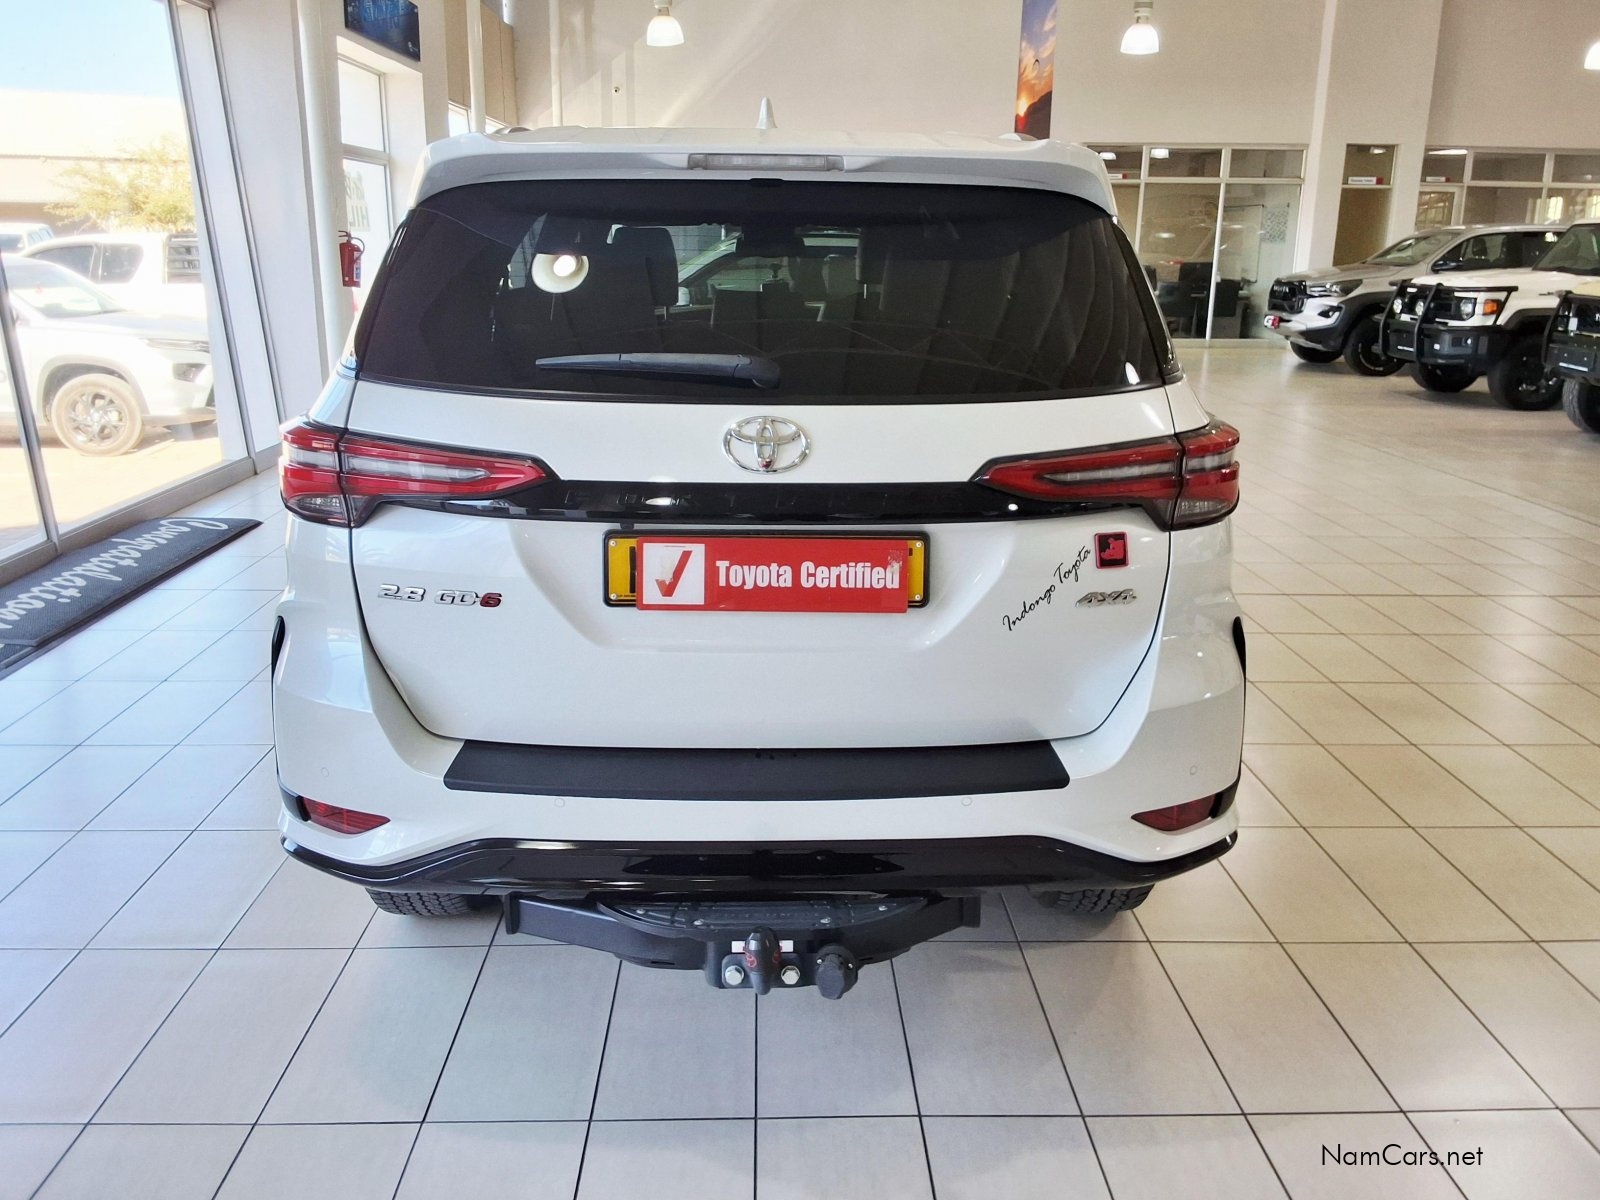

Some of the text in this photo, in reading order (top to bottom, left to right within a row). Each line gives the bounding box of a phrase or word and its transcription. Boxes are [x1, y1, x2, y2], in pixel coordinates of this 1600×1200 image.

[715, 560, 899, 590] Toyota Certified
[1002, 546, 1091, 632] Indongo Toyota
[377, 583, 426, 602] 2.8
